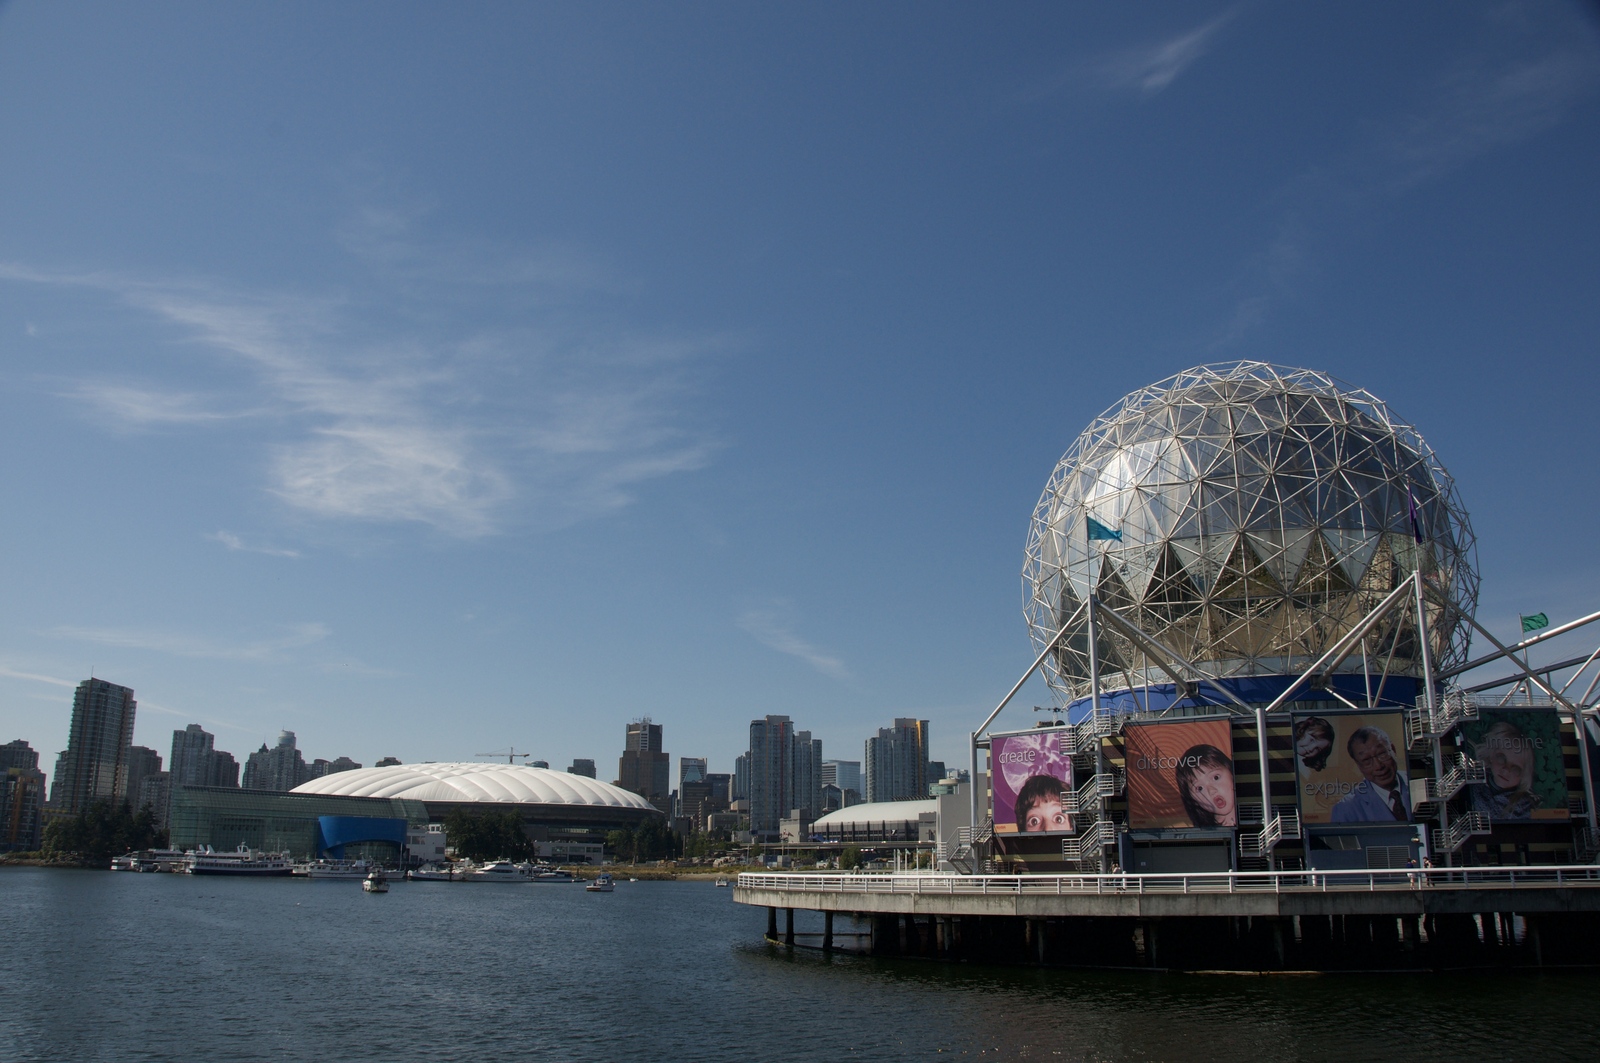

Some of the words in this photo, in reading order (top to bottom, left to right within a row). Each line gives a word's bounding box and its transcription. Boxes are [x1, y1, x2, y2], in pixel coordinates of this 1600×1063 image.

[1485, 734, 1543, 754] imagine
[998, 749, 1036, 764] create
[1136, 754, 1203, 770] discover
[1304, 777, 1368, 799] explore
